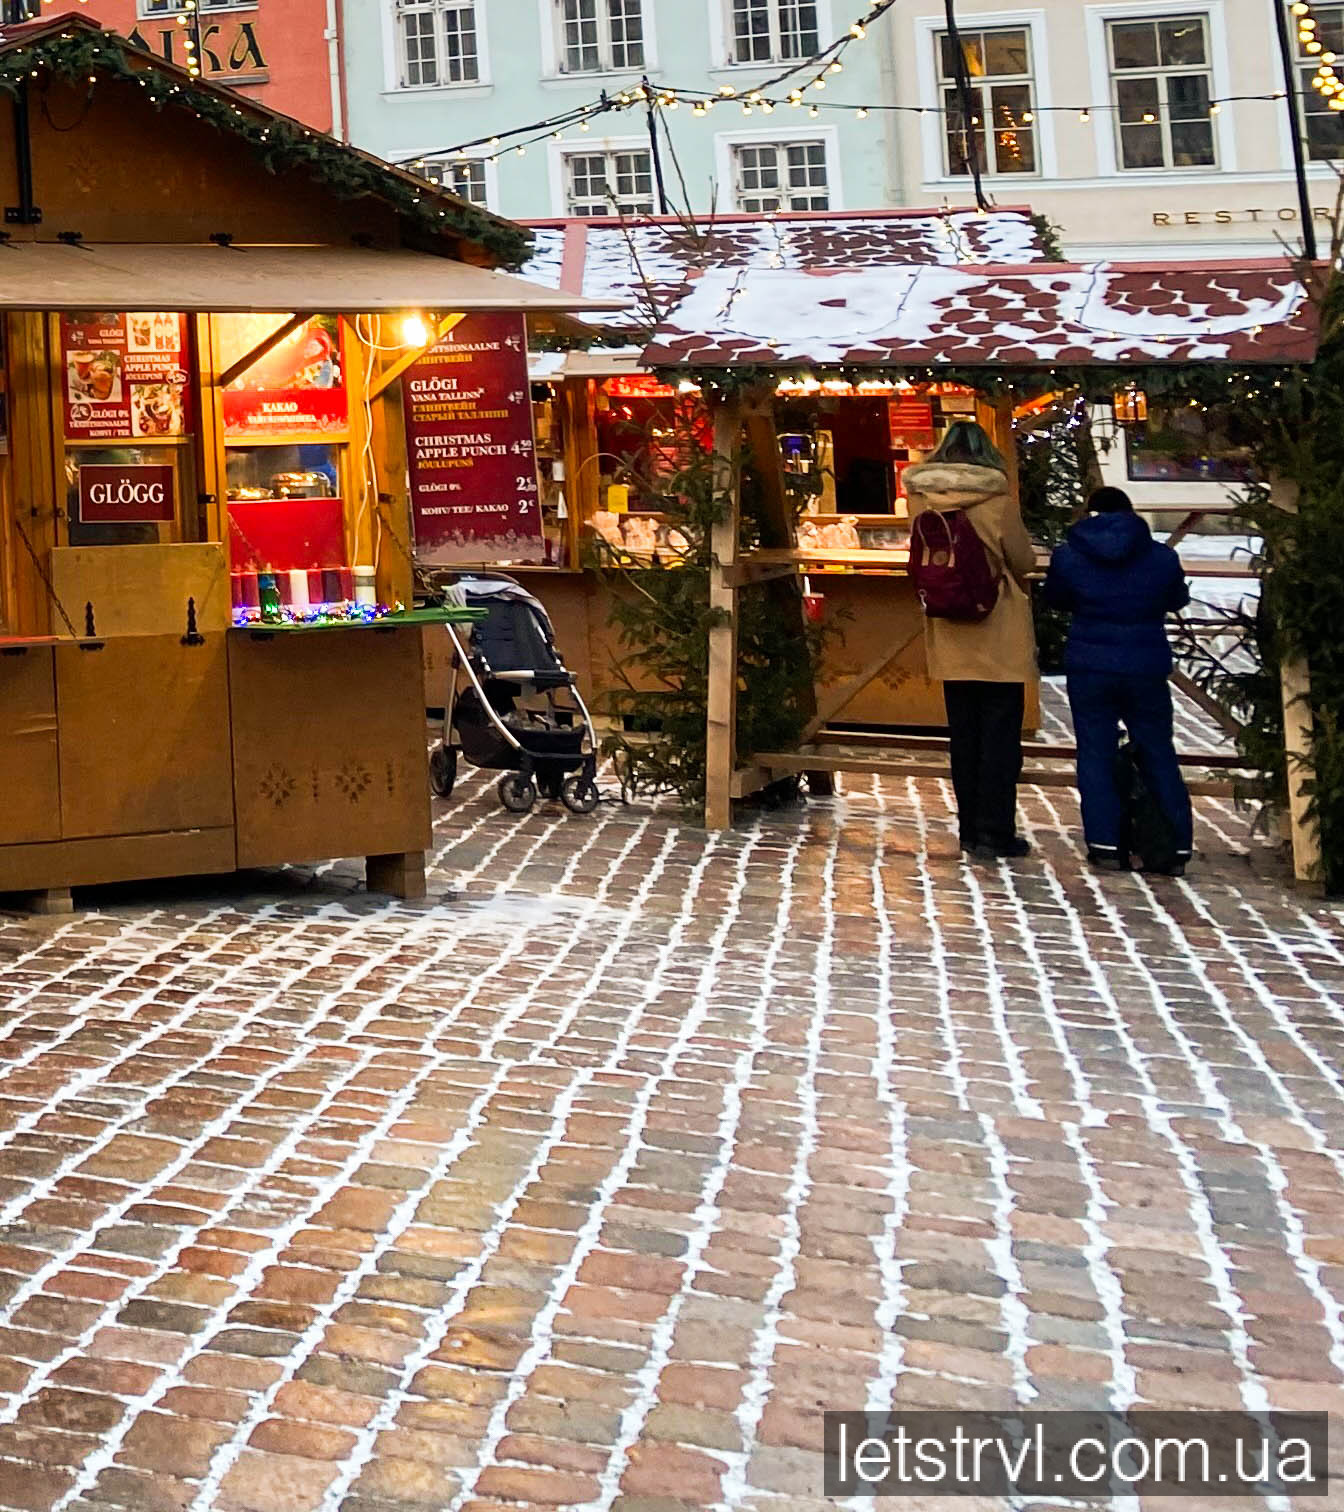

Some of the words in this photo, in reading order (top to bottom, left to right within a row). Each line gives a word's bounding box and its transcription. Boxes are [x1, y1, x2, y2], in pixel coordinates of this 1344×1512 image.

[1153, 207, 1330, 226] RESTOR
[411, 393, 437, 402] VANA
[438, 391, 481, 401] TALLINN
[262, 402, 298, 413] KAKAO
[415, 433, 492, 447] CHRISTMAS
[416, 446, 458, 459] APPLE
[461, 444, 507, 457] PUNCH
[90, 478, 165, 504] GLÖGG
[475, 503, 509, 513] KAKAO
